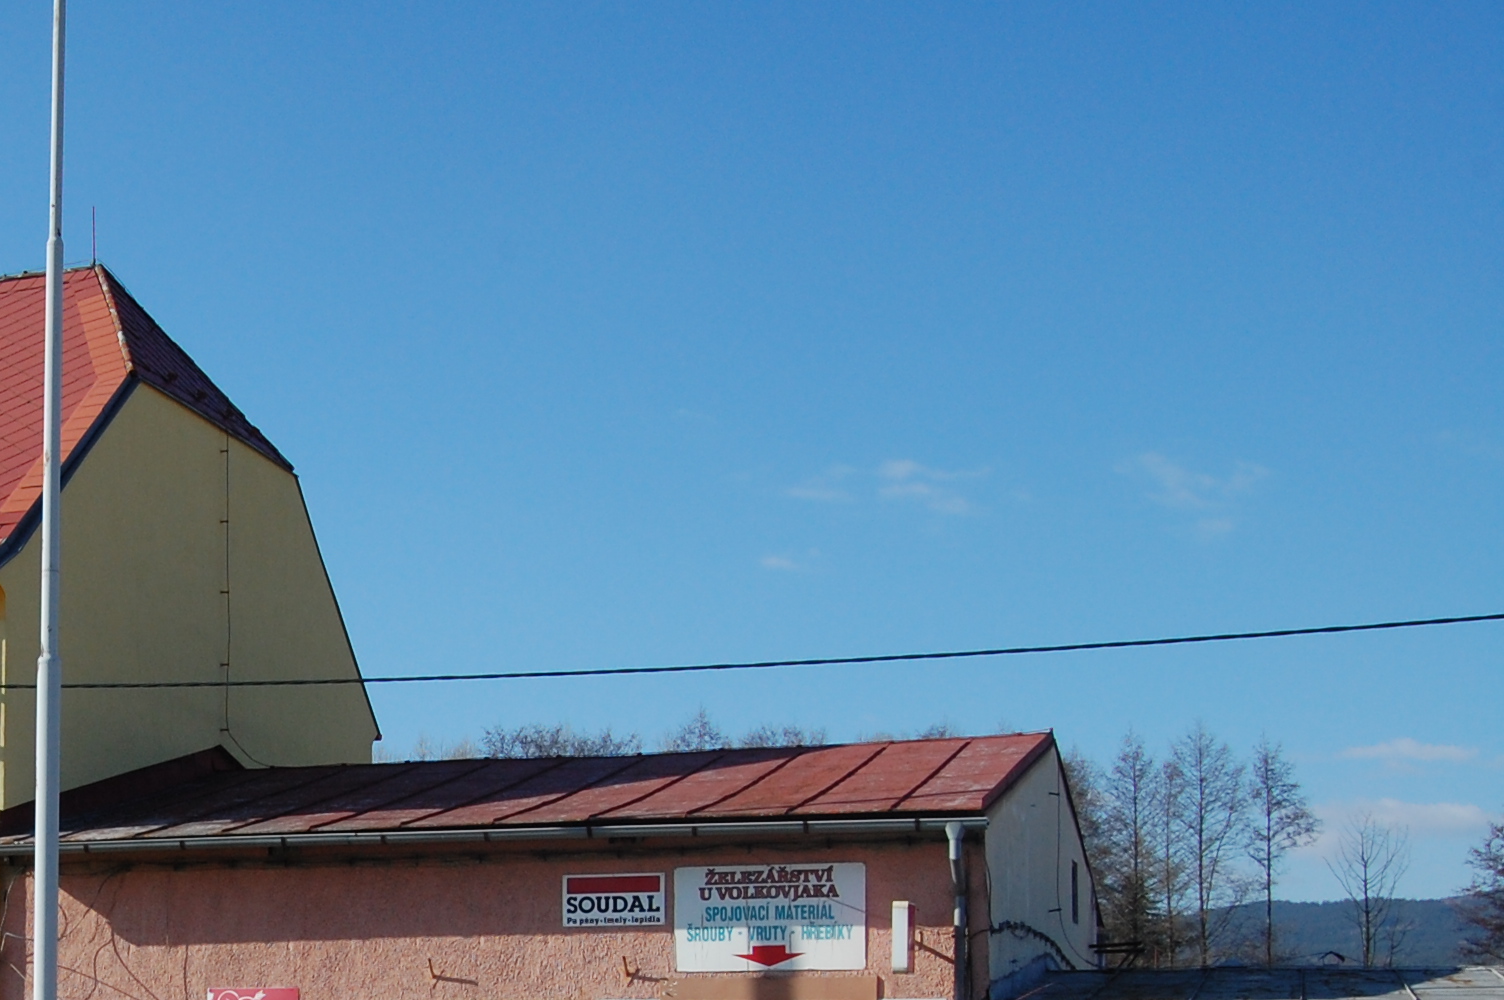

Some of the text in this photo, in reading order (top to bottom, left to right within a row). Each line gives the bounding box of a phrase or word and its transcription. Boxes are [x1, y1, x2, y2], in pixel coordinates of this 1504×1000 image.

[705, 865, 834, 886] ŽELEZÁŘSTVÍ
[698, 884, 840, 902] U VOLKOVJAKA
[566, 895, 660, 914] SOUDAL
[705, 901, 834, 922] SPOJOVACÍ MATERIÁL
[687, 923, 733, 942] ŠROUBY
[747, 926, 787, 941] VRUTY
[801, 920, 852, 941] HŘEBÍKY
